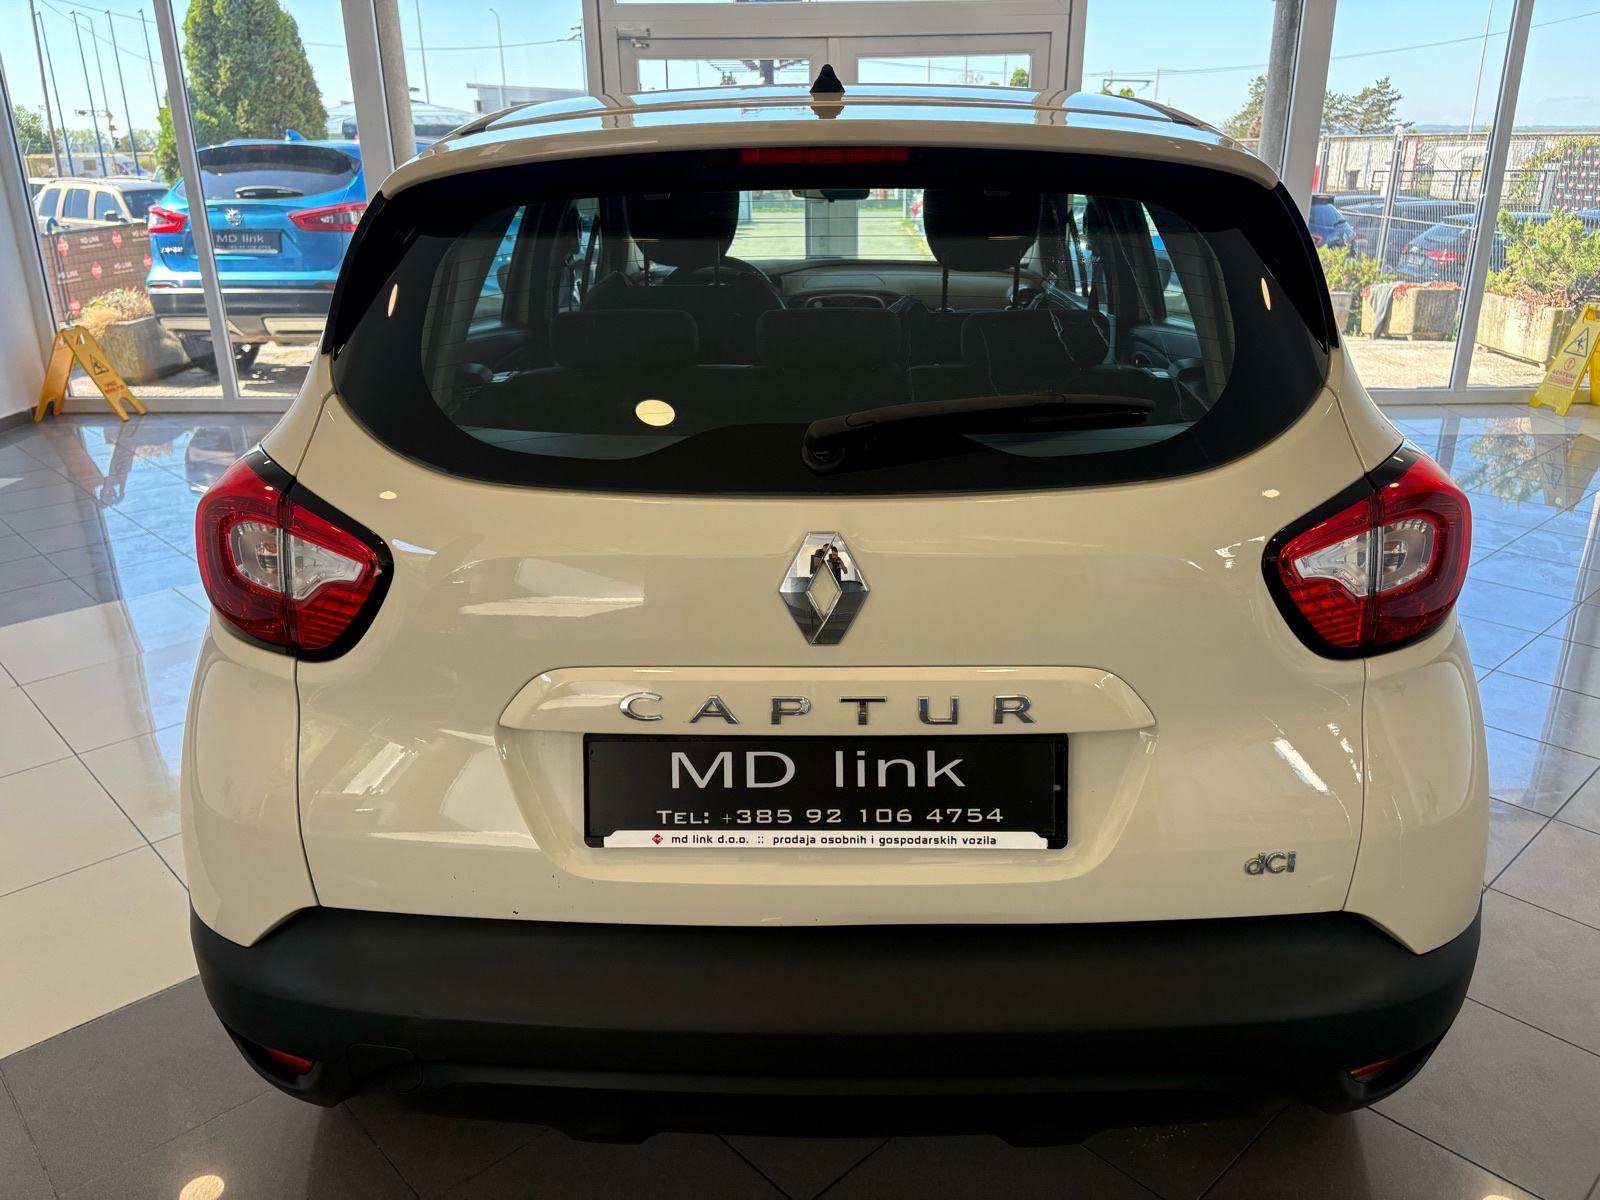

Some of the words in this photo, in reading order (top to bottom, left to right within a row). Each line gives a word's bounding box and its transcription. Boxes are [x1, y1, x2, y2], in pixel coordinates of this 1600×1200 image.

[216, 234, 237, 243] MD
[242, 233, 264, 243] link
[618, 692, 1037, 726] CAPTUR
[671, 751, 796, 789] MD
[835, 750, 966, 788] link
[722, 809, 793, 824] +385
[806, 808, 842, 824] 92
[859, 808, 913, 823] 106
[926, 808, 1004, 823] 4754
[671, 834, 689, 844] md
[693, 834, 713, 844] link
[717, 834, 750, 844] d.o.o.
[773, 834, 816, 846] prodaja
[821, 835, 867, 845] osobnih
[871, 835, 875, 845] i
[879, 835, 957, 847] gospodarskih
[962, 835, 997, 846] vozila
